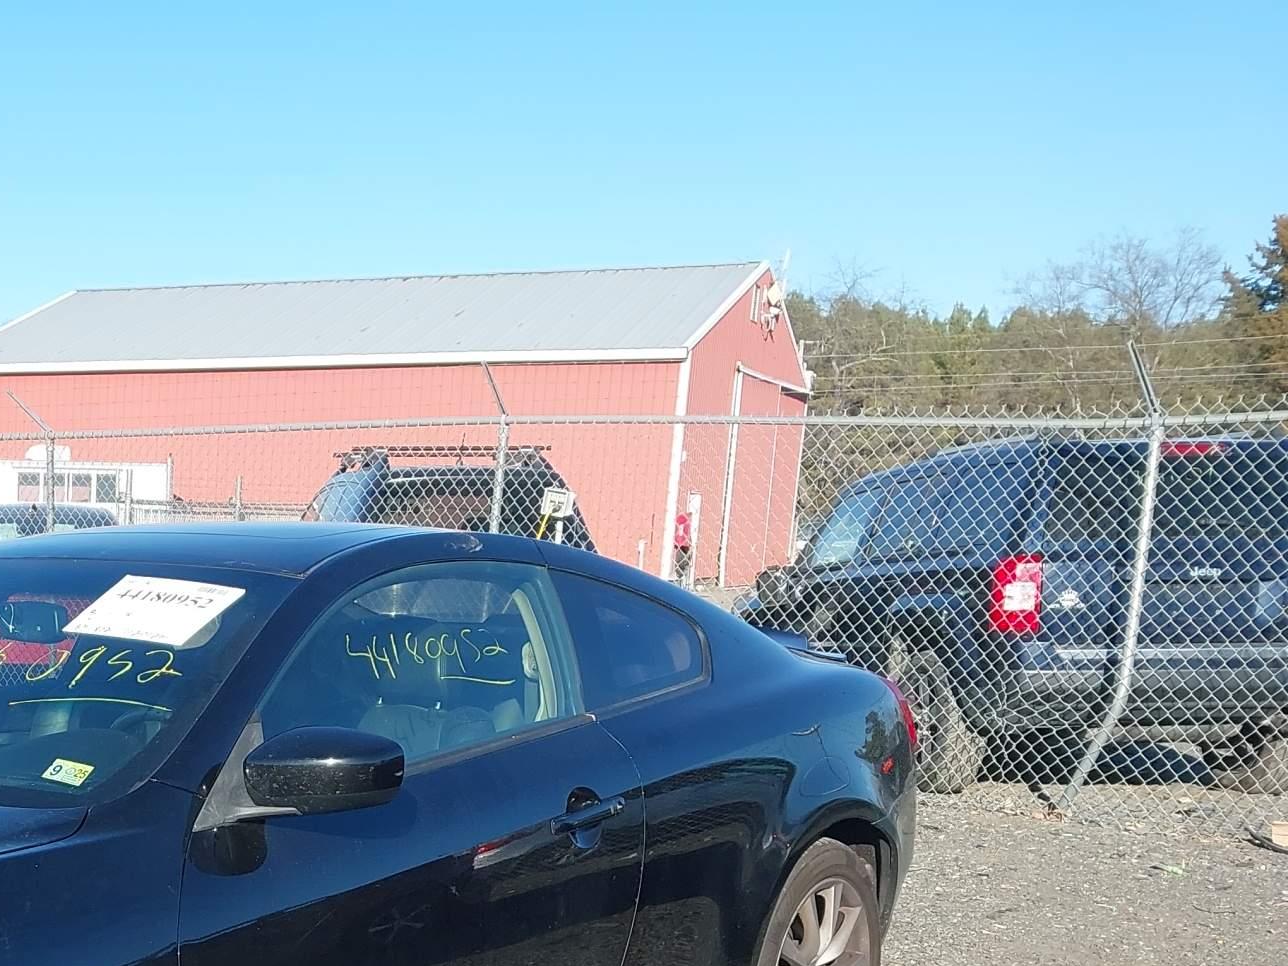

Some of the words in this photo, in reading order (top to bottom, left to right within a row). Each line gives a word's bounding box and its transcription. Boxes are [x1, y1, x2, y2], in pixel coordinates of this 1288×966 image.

[1189, 566, 1223, 580] Jeep
[117, 588, 215, 610] 44180952
[346, 628, 509, 680] 44180952
[50, 764, 63, 775] 9
[74, 768, 89, 779] 25
